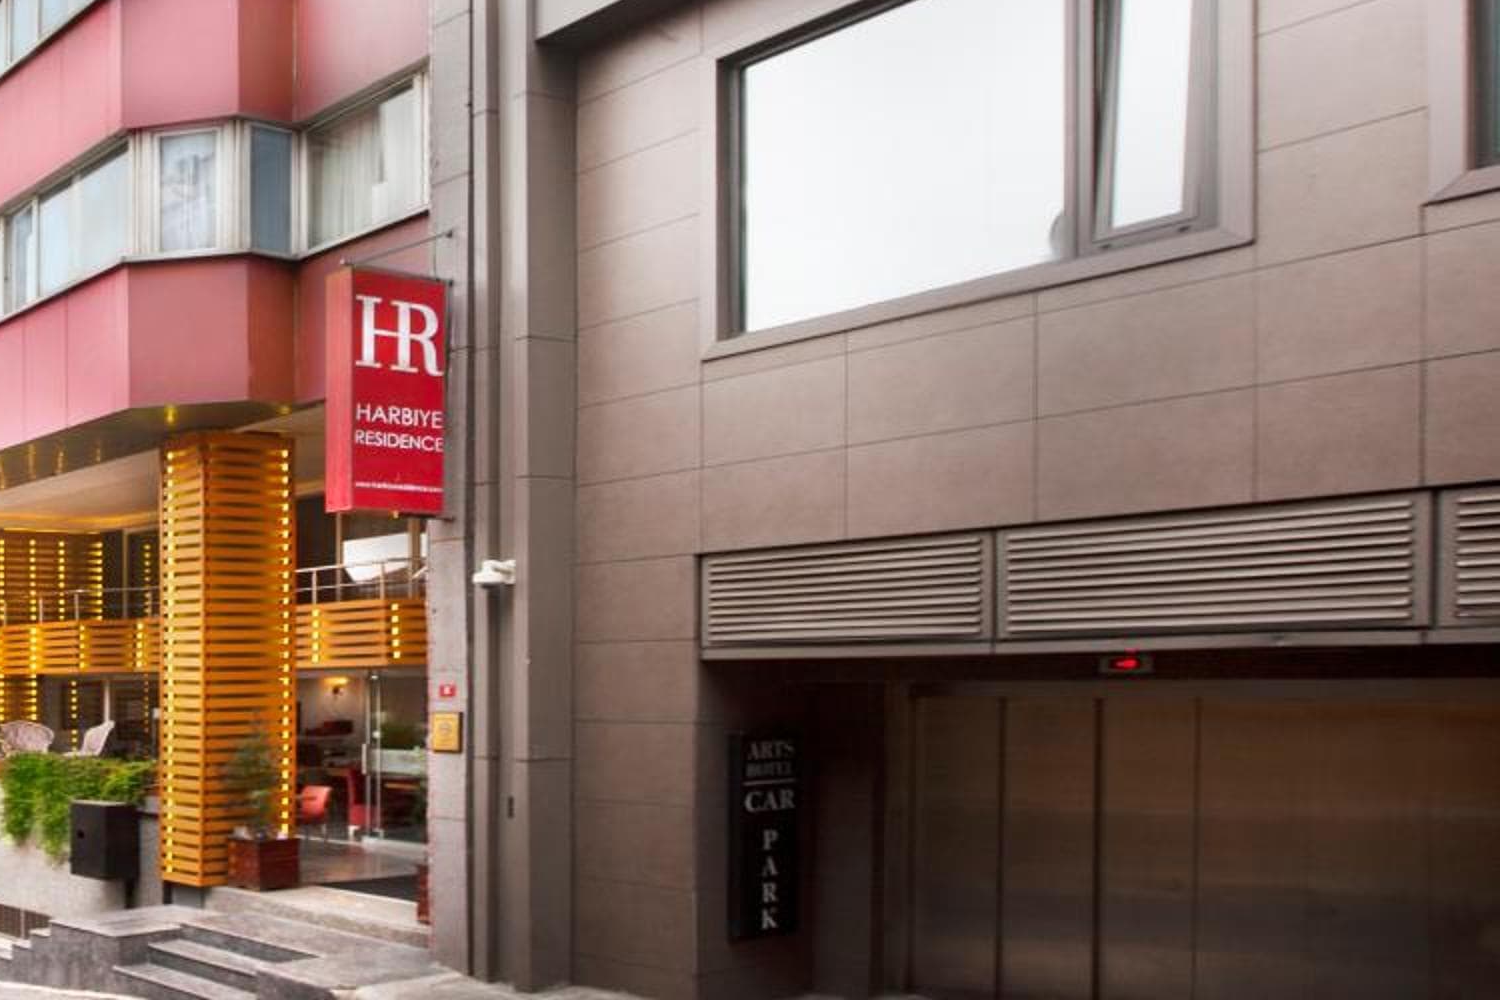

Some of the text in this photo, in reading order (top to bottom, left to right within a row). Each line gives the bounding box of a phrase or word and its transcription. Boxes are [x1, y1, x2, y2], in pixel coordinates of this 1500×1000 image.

[355, 294, 444, 377] HR
[356, 403, 443, 429] HARBIYE
[355, 429, 443, 453] RESIDENCE
[744, 788, 795, 812] CAR
[761, 829, 778, 929] PARK
